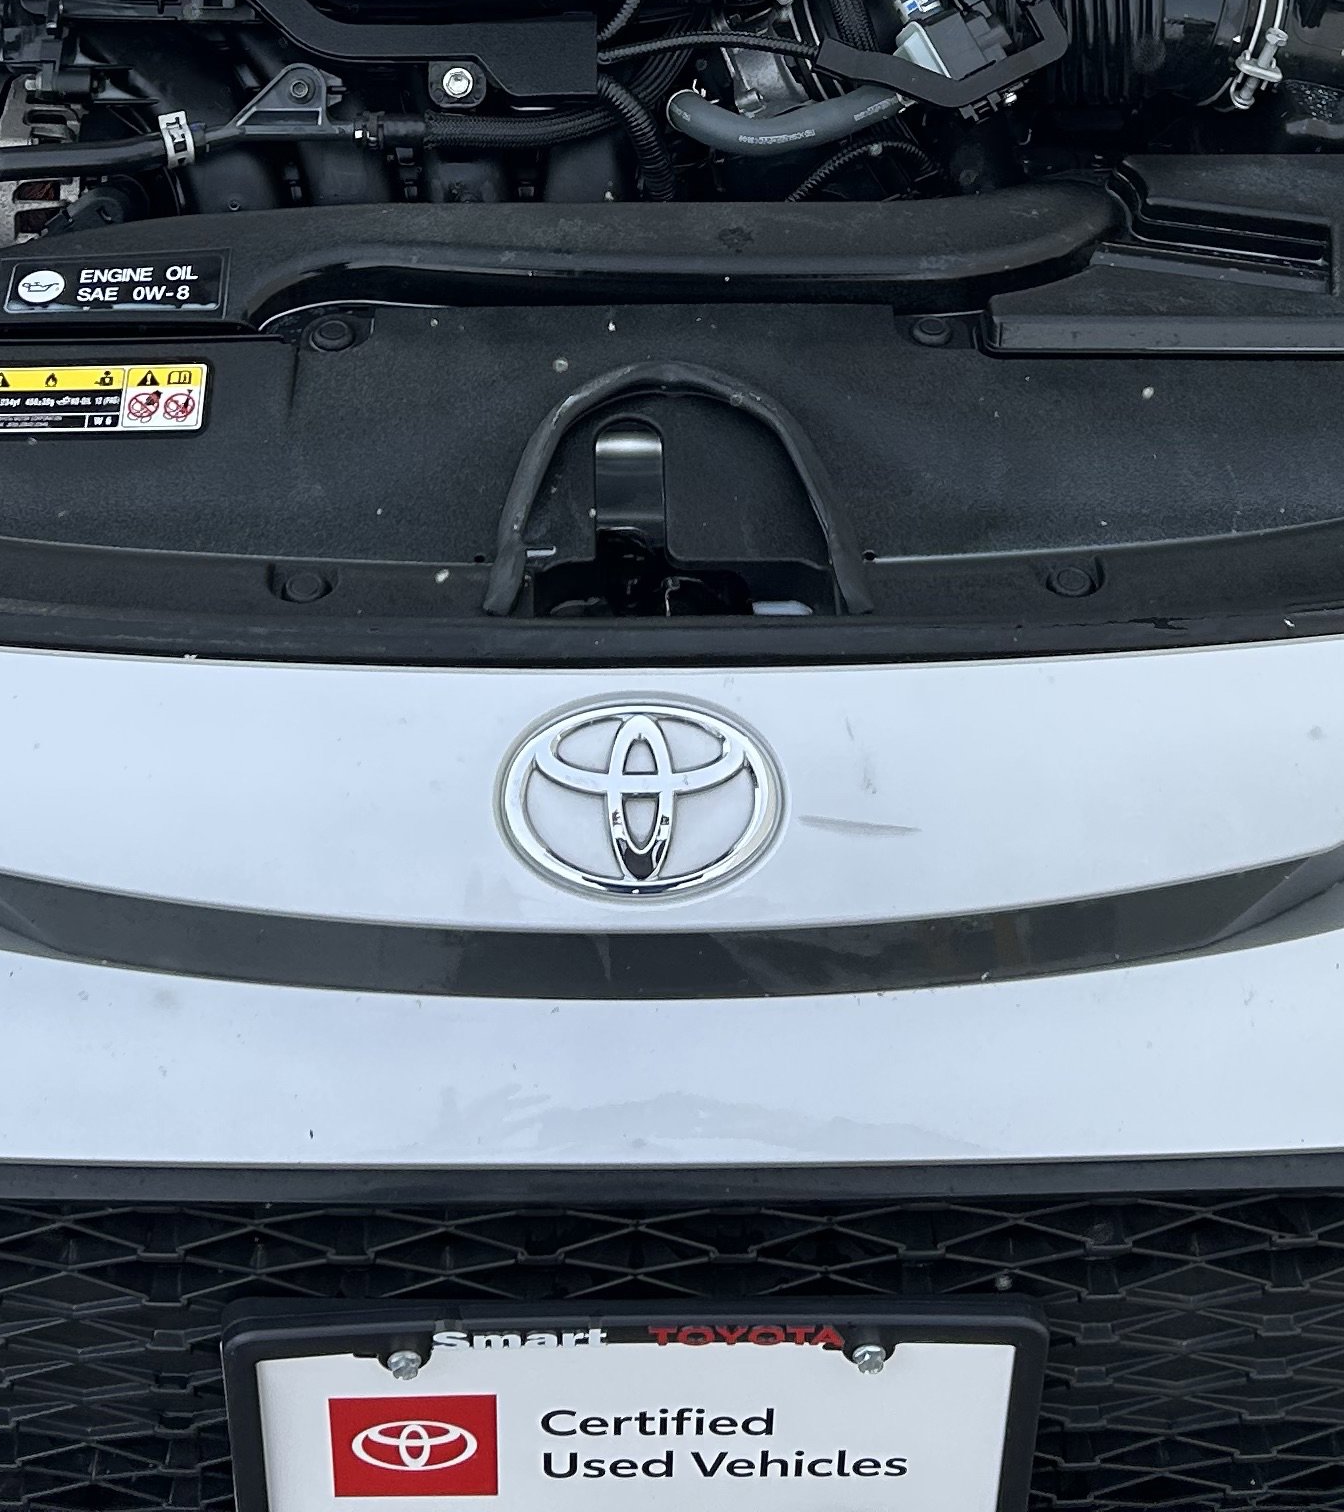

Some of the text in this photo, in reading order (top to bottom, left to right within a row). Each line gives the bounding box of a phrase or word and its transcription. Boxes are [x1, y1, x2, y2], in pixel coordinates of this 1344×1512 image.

[79, 265, 199, 284] ENGINE OIL
[76, 285, 190, 302] SAE 0W-8
[432, 1325, 845, 1349] Smart TOYOTA
[540, 1407, 775, 1438] Certified
[543, 1450, 909, 1480] Used Vehicles
